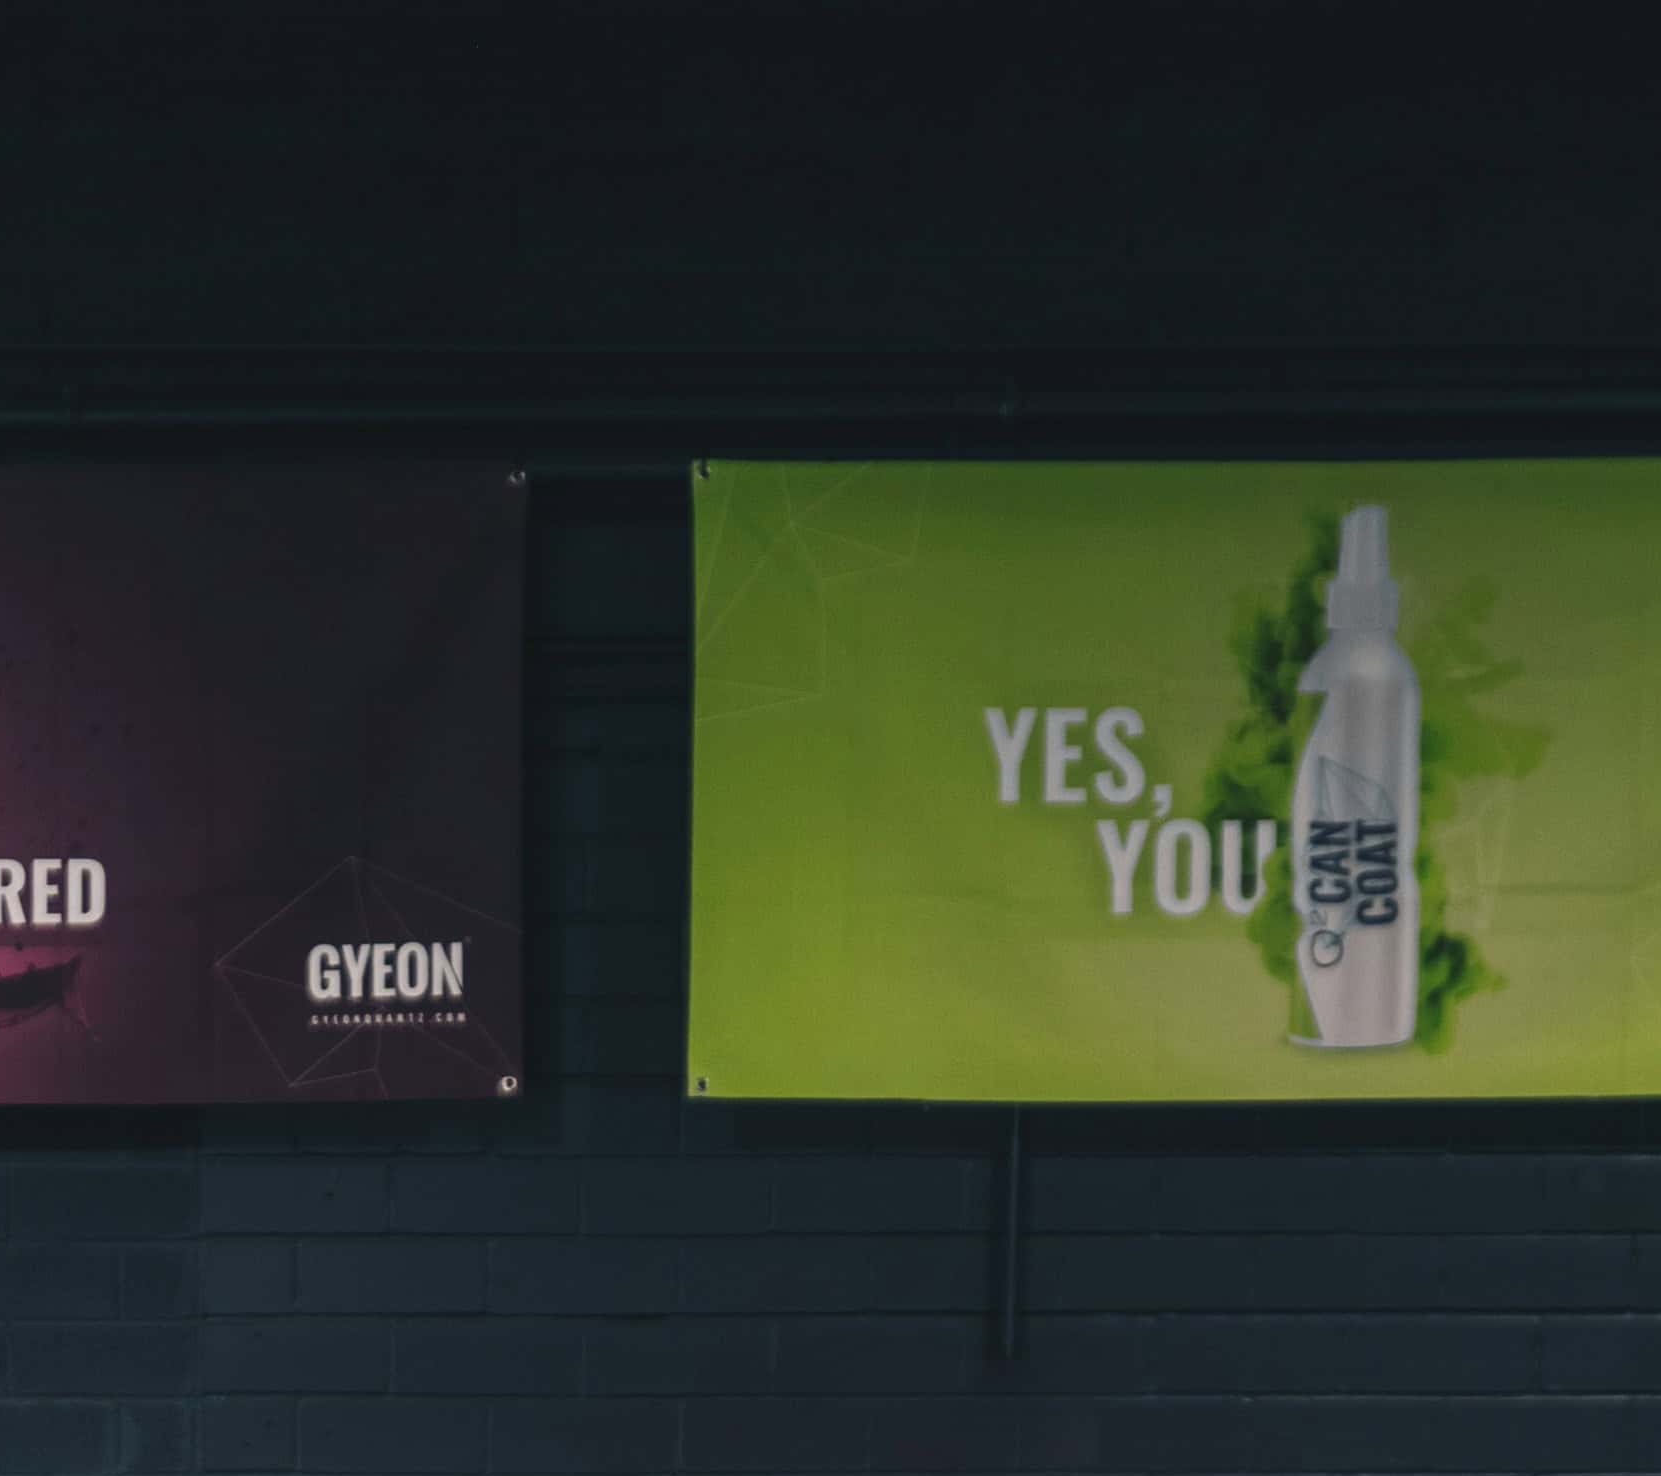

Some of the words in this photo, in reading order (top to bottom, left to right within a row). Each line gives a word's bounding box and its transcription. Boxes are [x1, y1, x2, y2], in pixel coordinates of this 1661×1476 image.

[984, 706, 1173, 817] YES,
[1096, 818, 1276, 916] YOU
[1309, 820, 1352, 905] CAN
[1355, 818, 1399, 927] COAT
[308, 942, 464, 1000] GYEON
